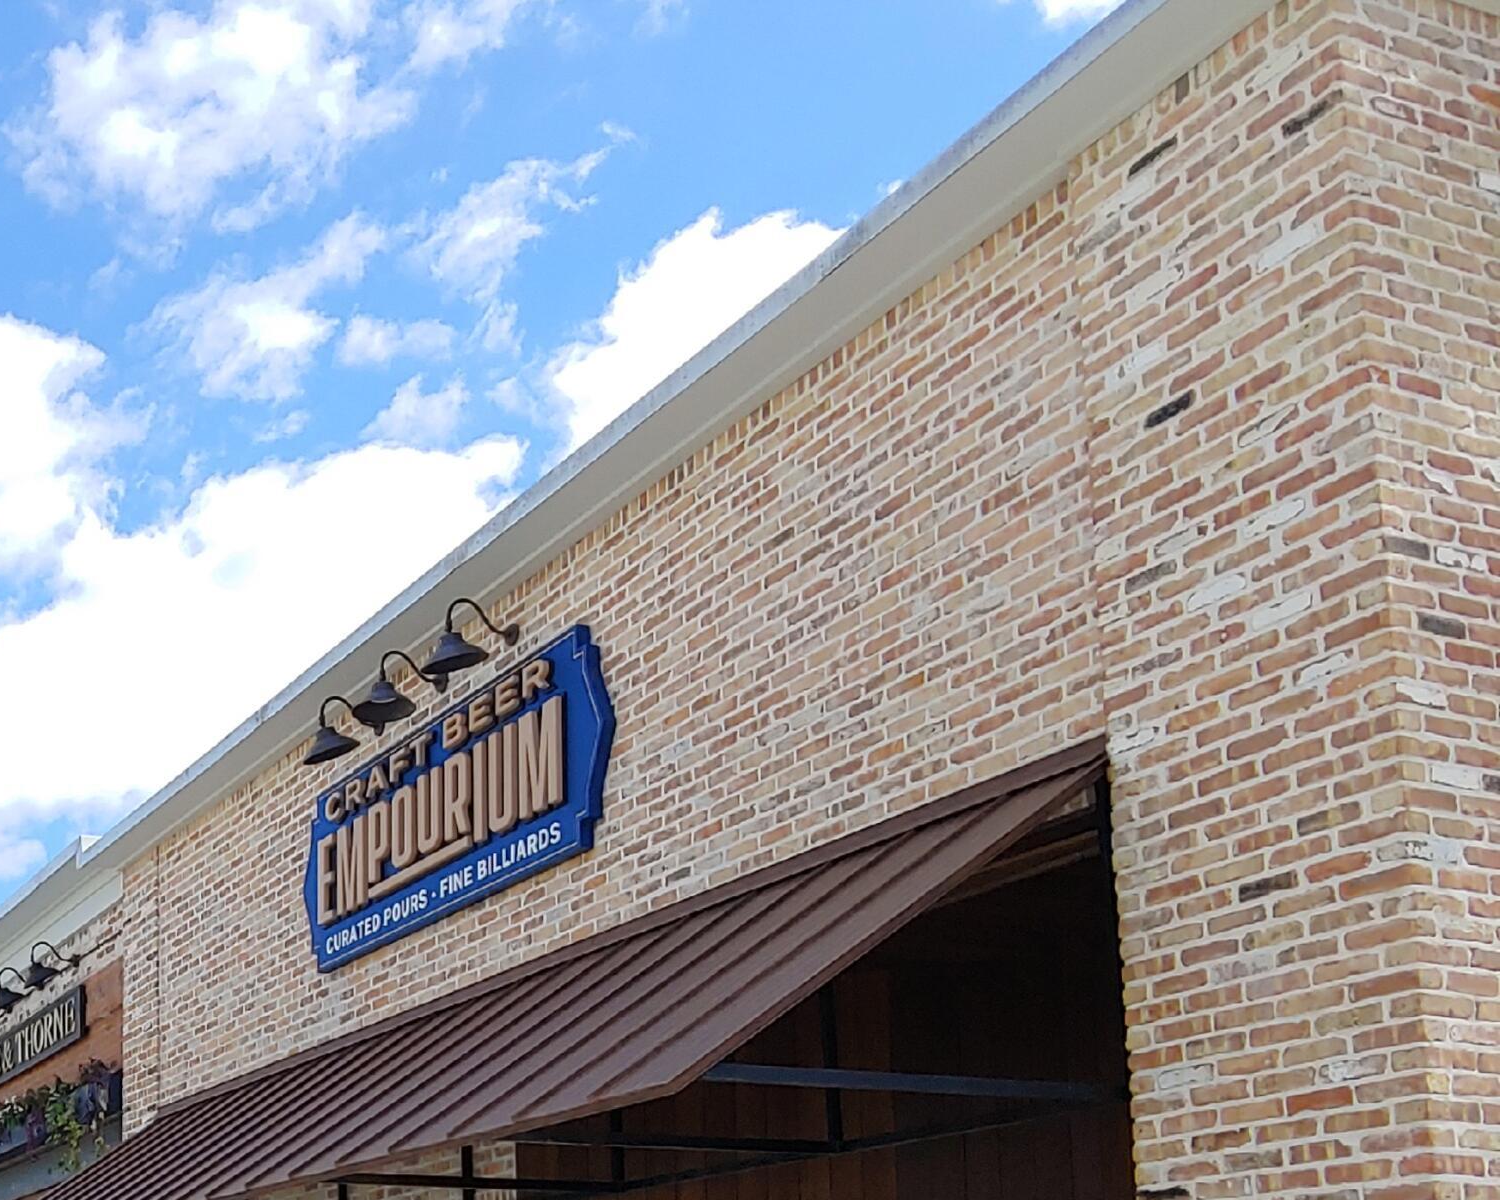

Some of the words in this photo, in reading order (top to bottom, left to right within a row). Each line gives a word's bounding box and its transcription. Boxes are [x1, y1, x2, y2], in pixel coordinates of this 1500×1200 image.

[316, 695, 565, 926] EMPOURIUM
[325, 732, 434, 823] CRAFT
[442, 658, 551, 750] BEER
[325, 913, 381, 955] CURATED
[383, 888, 429, 928] POURS
[439, 864, 475, 899] FINE
[477, 821, 563, 880] BILLIARDS
[2, 1038, 14, 1074] &
[14, 998, 77, 1063] THORNE
